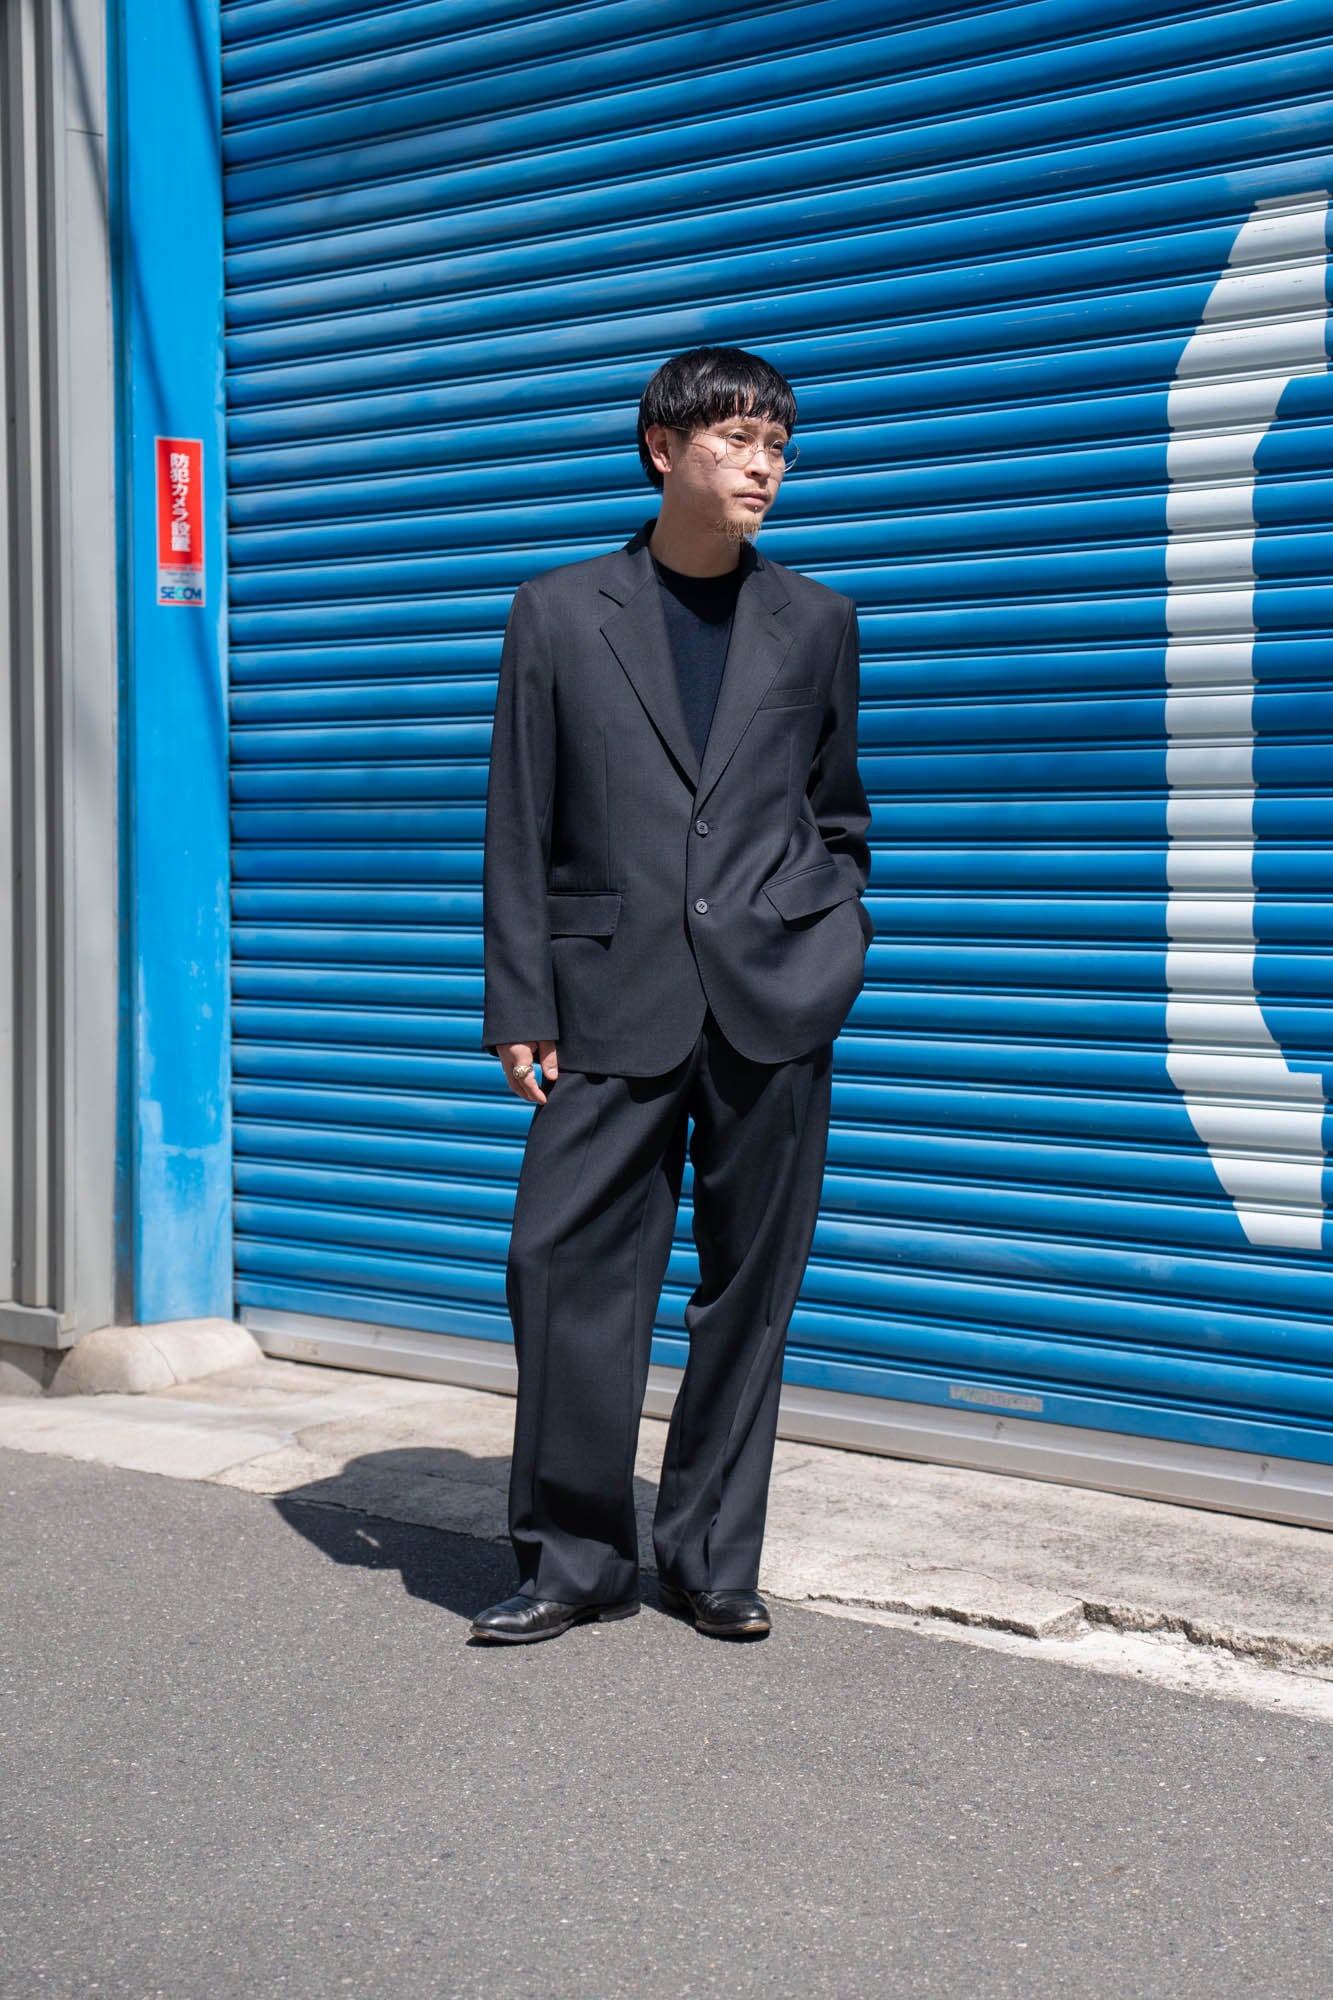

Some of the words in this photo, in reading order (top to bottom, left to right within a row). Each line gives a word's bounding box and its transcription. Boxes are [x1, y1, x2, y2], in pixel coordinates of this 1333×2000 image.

[169, 453, 191, 552] 防犯カメラ設置
[160, 586, 202, 600] SECOM
